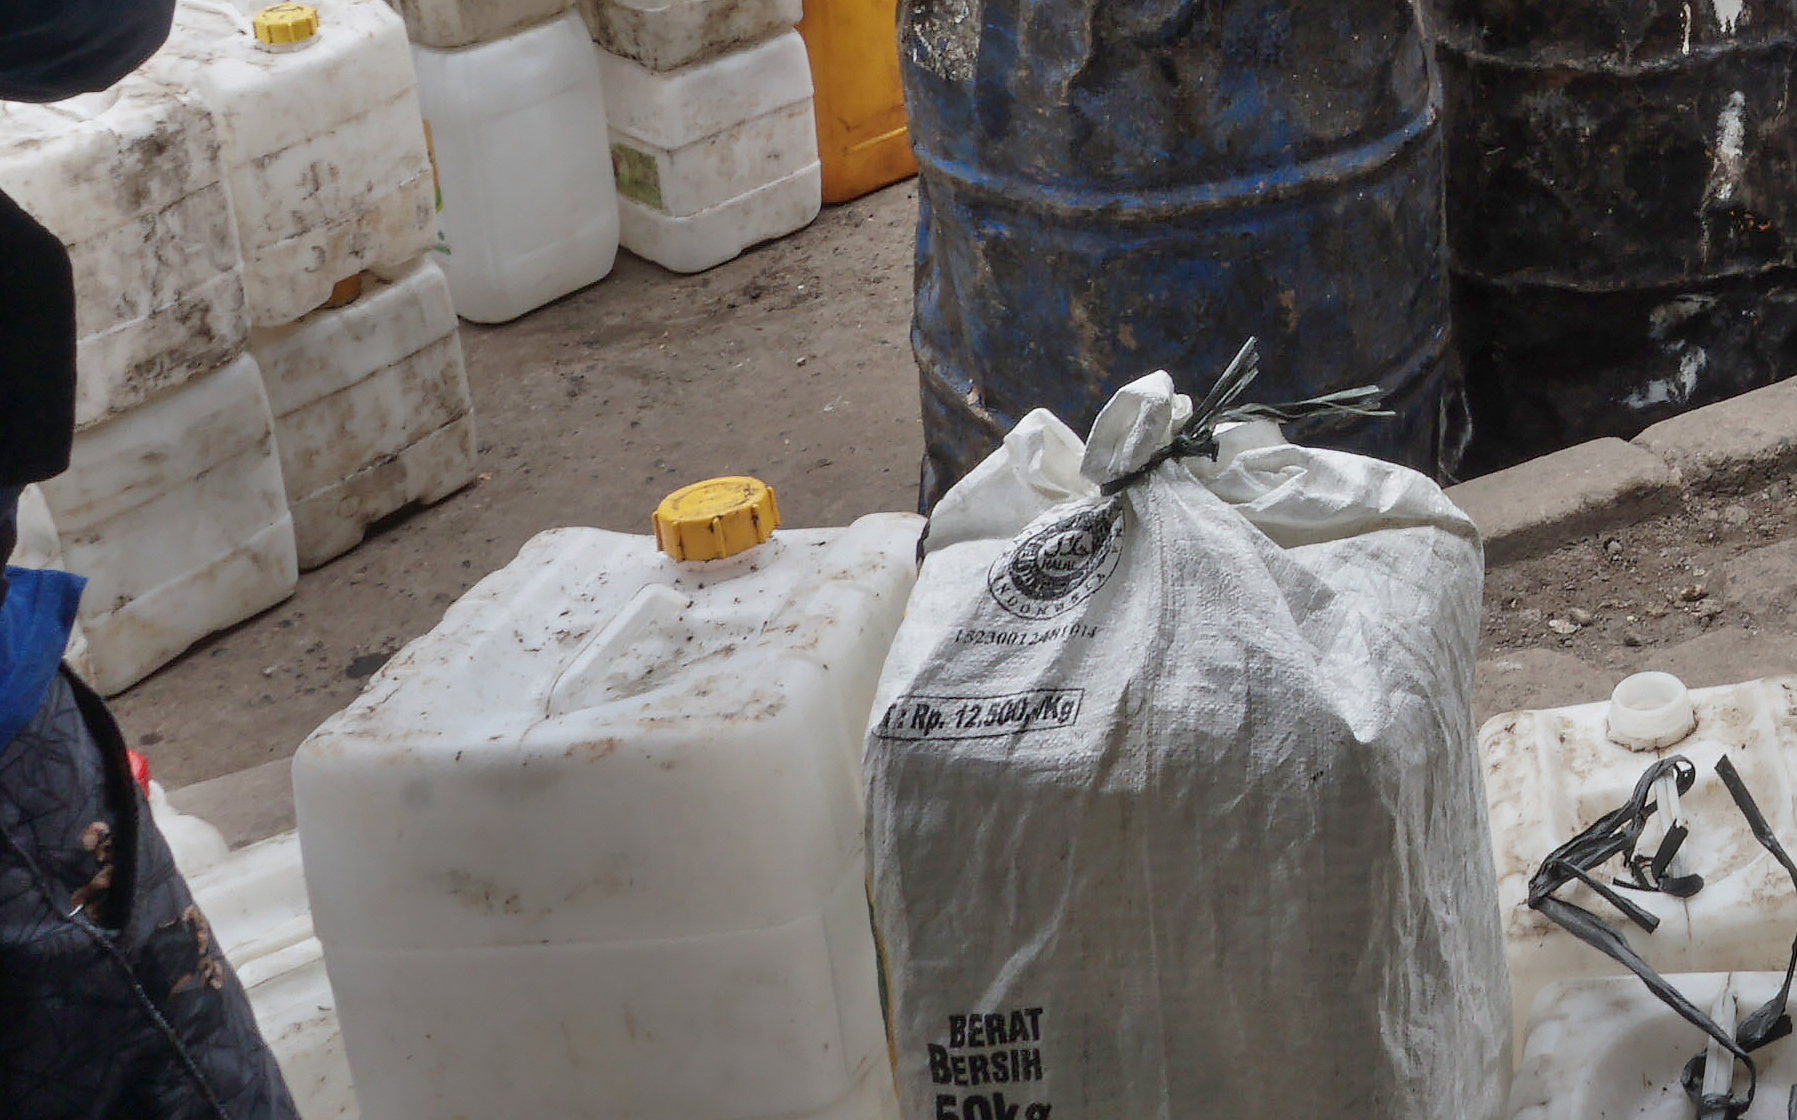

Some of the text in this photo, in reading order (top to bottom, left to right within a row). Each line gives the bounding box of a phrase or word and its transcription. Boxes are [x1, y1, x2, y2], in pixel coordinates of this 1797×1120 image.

[911, 703, 945, 737] Rp.
[949, 1007, 1044, 1049] BERAT
[927, 1043, 1043, 1087] BERSIH
